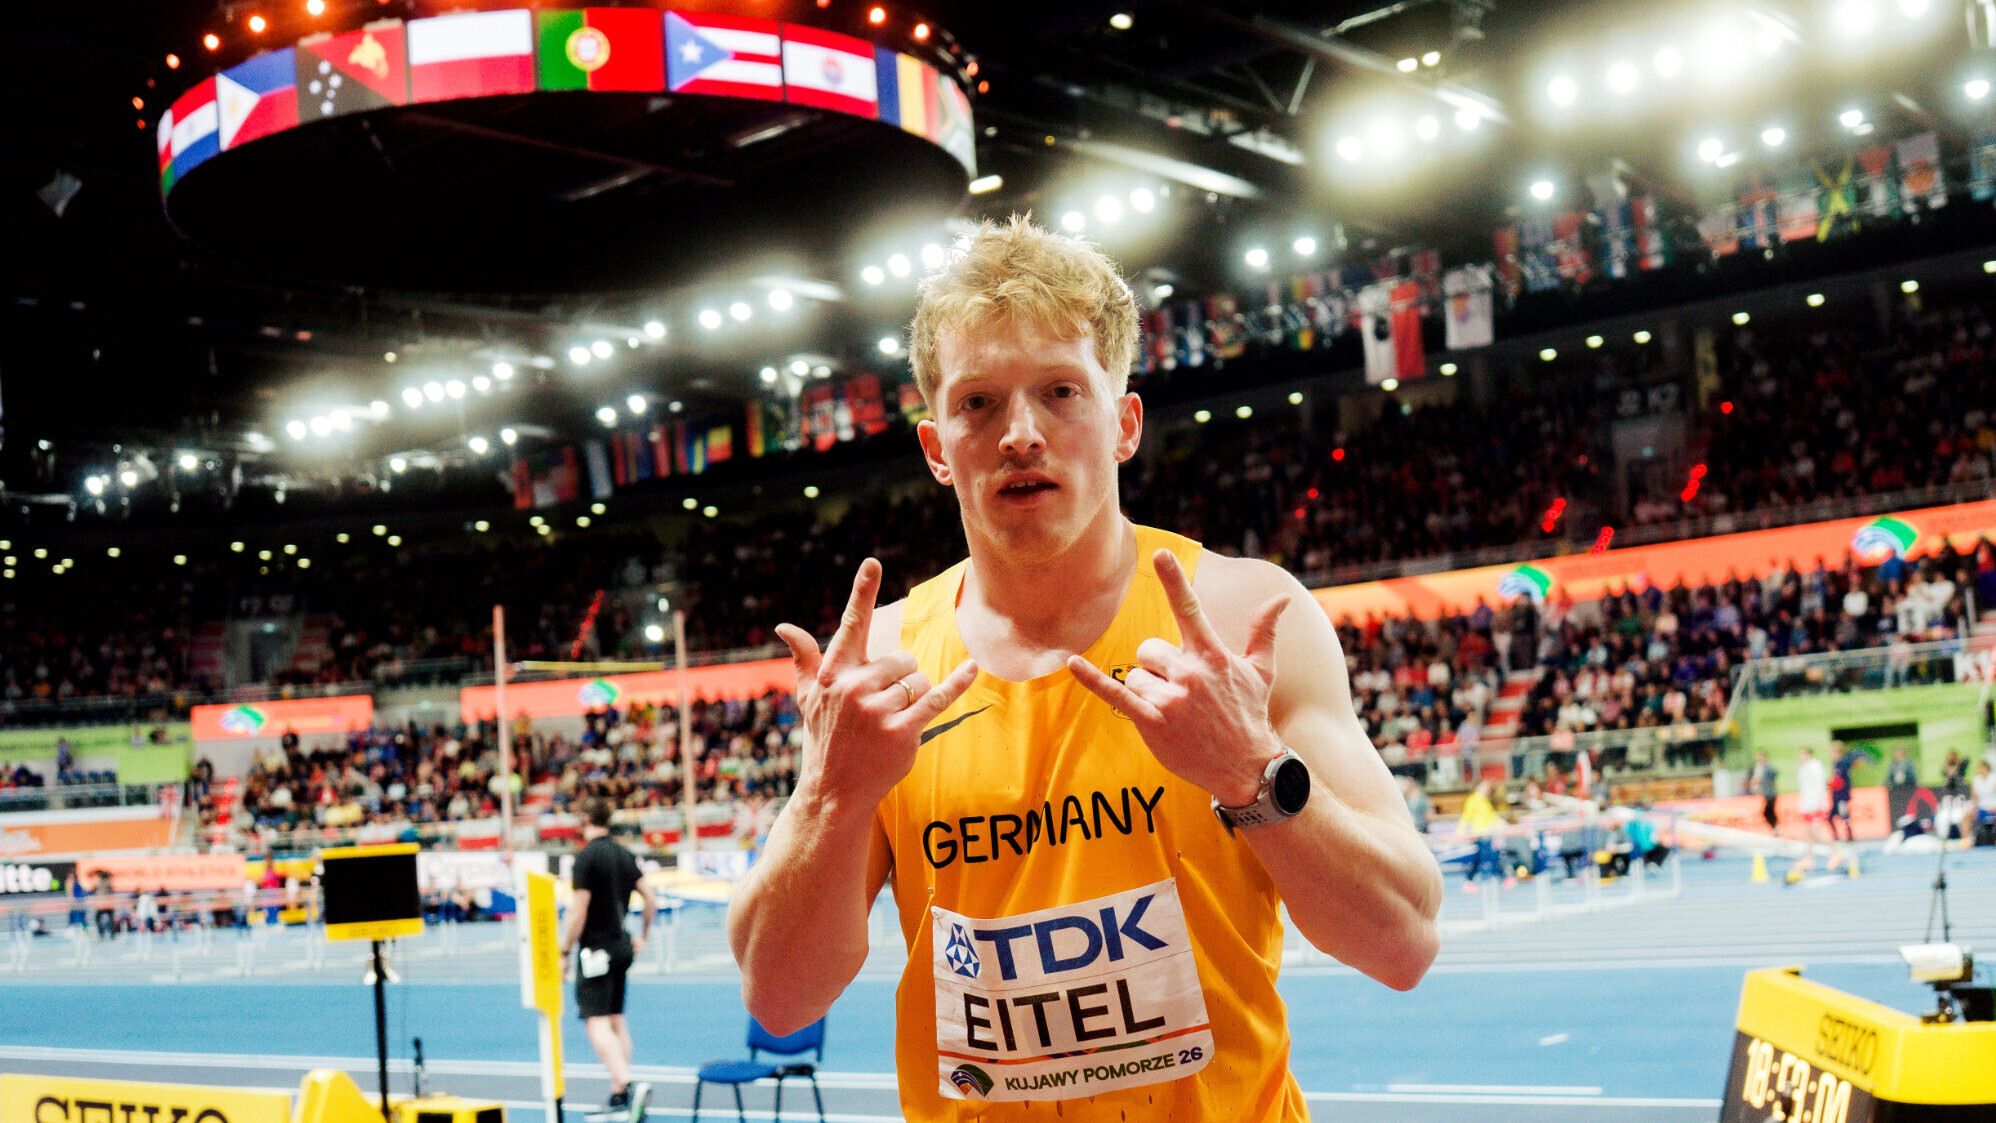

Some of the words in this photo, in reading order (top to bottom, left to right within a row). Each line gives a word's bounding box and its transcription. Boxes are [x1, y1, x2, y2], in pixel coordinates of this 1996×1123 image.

[922, 786, 1165, 869] GERMANY
[973, 893, 1170, 981] TDK
[963, 978, 1166, 1052] EITEL
[1815, 1012, 1878, 1075] SEIKO
[1005, 1068, 1079, 1091] KUJAWY
[1083, 1053, 1176, 1083] POMORZE
[1178, 1046, 1203, 1065] 26
